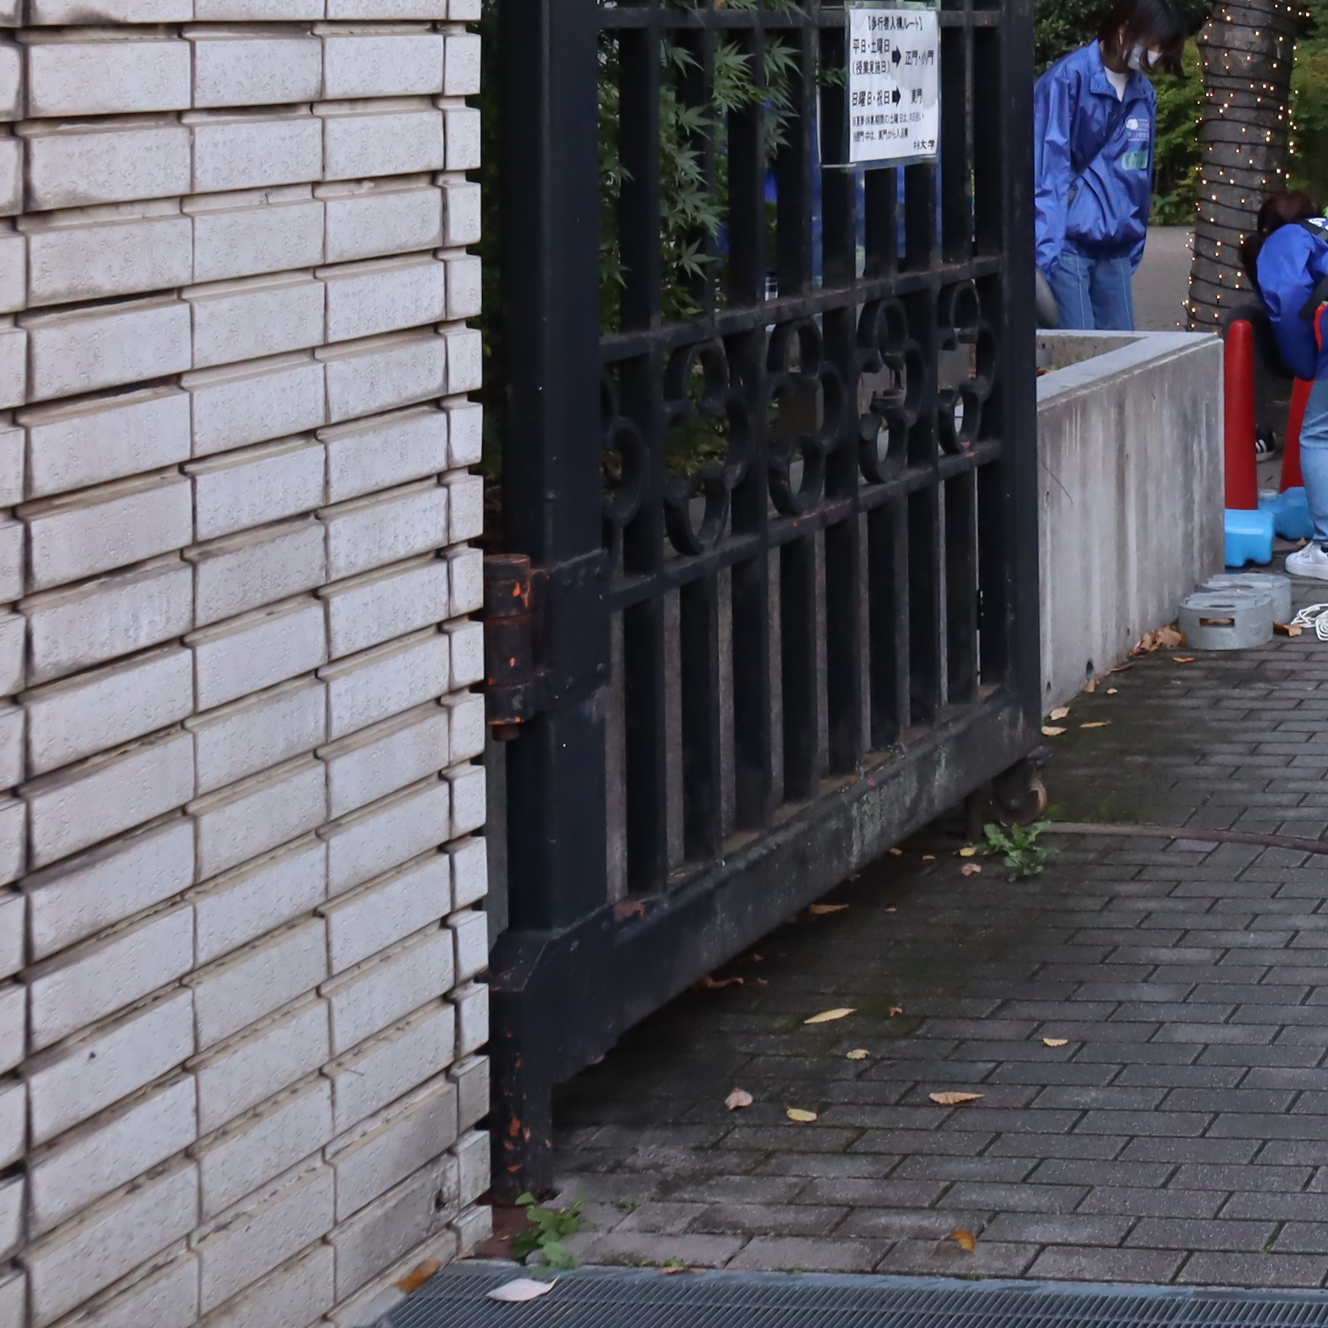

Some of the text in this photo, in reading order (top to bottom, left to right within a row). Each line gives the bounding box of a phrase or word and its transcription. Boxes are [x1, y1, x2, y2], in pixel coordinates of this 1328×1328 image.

[852, 38, 890, 54] 平日・土曜日
[904, 50, 934, 66] 正門・小門
[852, 90, 891, 107] 日曜日・祝日
[911, 88, 923, 105] 東門
